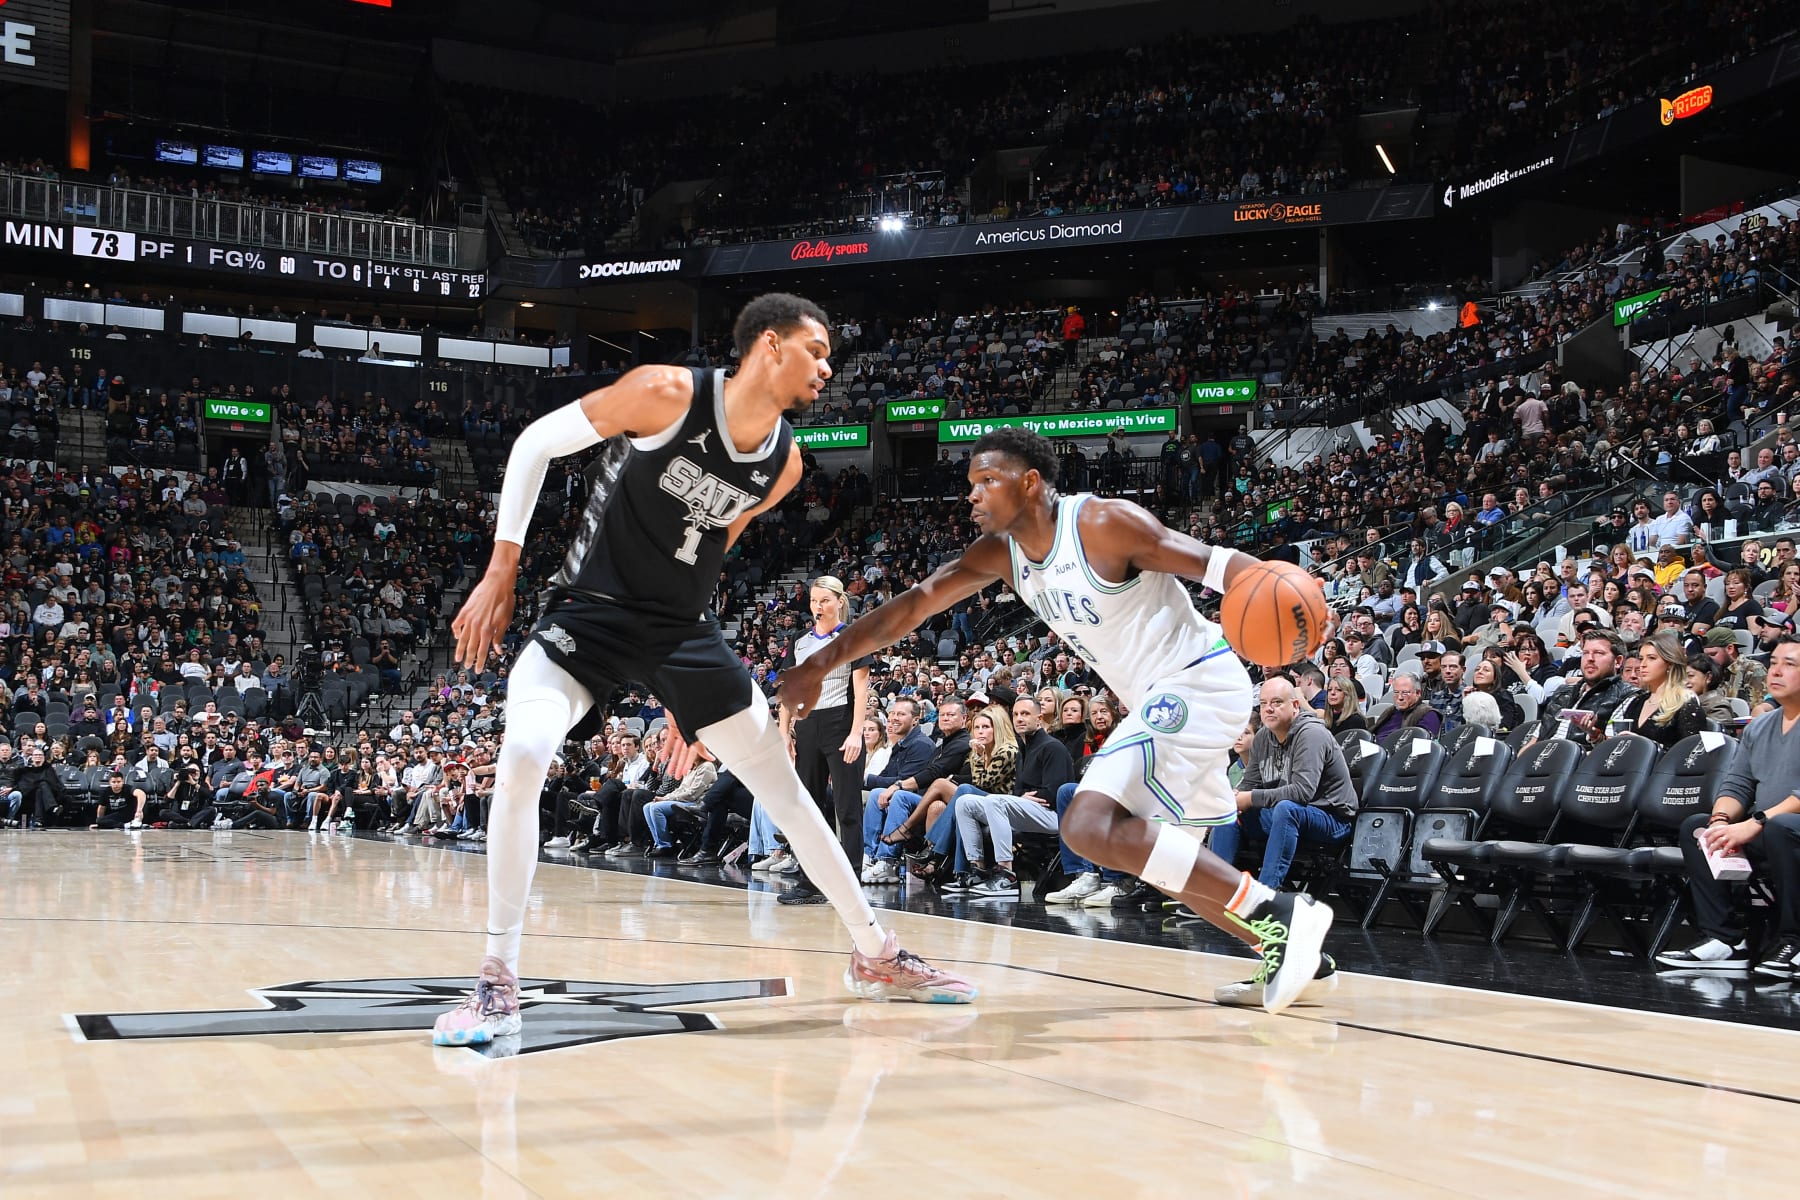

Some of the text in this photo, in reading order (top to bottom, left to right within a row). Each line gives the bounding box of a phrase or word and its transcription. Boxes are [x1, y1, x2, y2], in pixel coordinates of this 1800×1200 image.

[1460, 156, 1554, 199] Methodist HEALTHCARE
[1233, 204, 1322, 222] LUCKY EAGLE
[975, 219, 1123, 246] Americus Diamond
[5, 221, 361, 281] MIN 73 PF 1 FG% 60 TO 6
[791, 240, 868, 261] Bally SPORTS
[374, 265, 484, 284] BLK STL AST REB
[591, 259, 681, 278] DOCUMATION
[383, 276, 480, 297] 4 6 19 22
[70, 347, 92, 360] 115
[429, 381, 448, 392] 116
[1023, 421, 1041, 433] Fly
[1043, 420, 1057, 430] to
[1058, 417, 1103, 429] Mexico
[1105, 415, 1134, 426] with
[1136, 414, 1165, 425] Viva
[804, 432, 829, 443] with
[831, 430, 858, 441] Viva
[674, 526, 702, 566] 1
[1032, 588, 1103, 627] OLVES
[1531, 785, 1546, 793] STAR
[1575, 785, 1594, 793] LONE
[1594, 786, 1609, 794] STAR
[1666, 787, 1701, 795] LONE STAR
[1577, 795, 1608, 803] CHRYSLER
[1662, 796, 1700, 805] DODGE RAM
